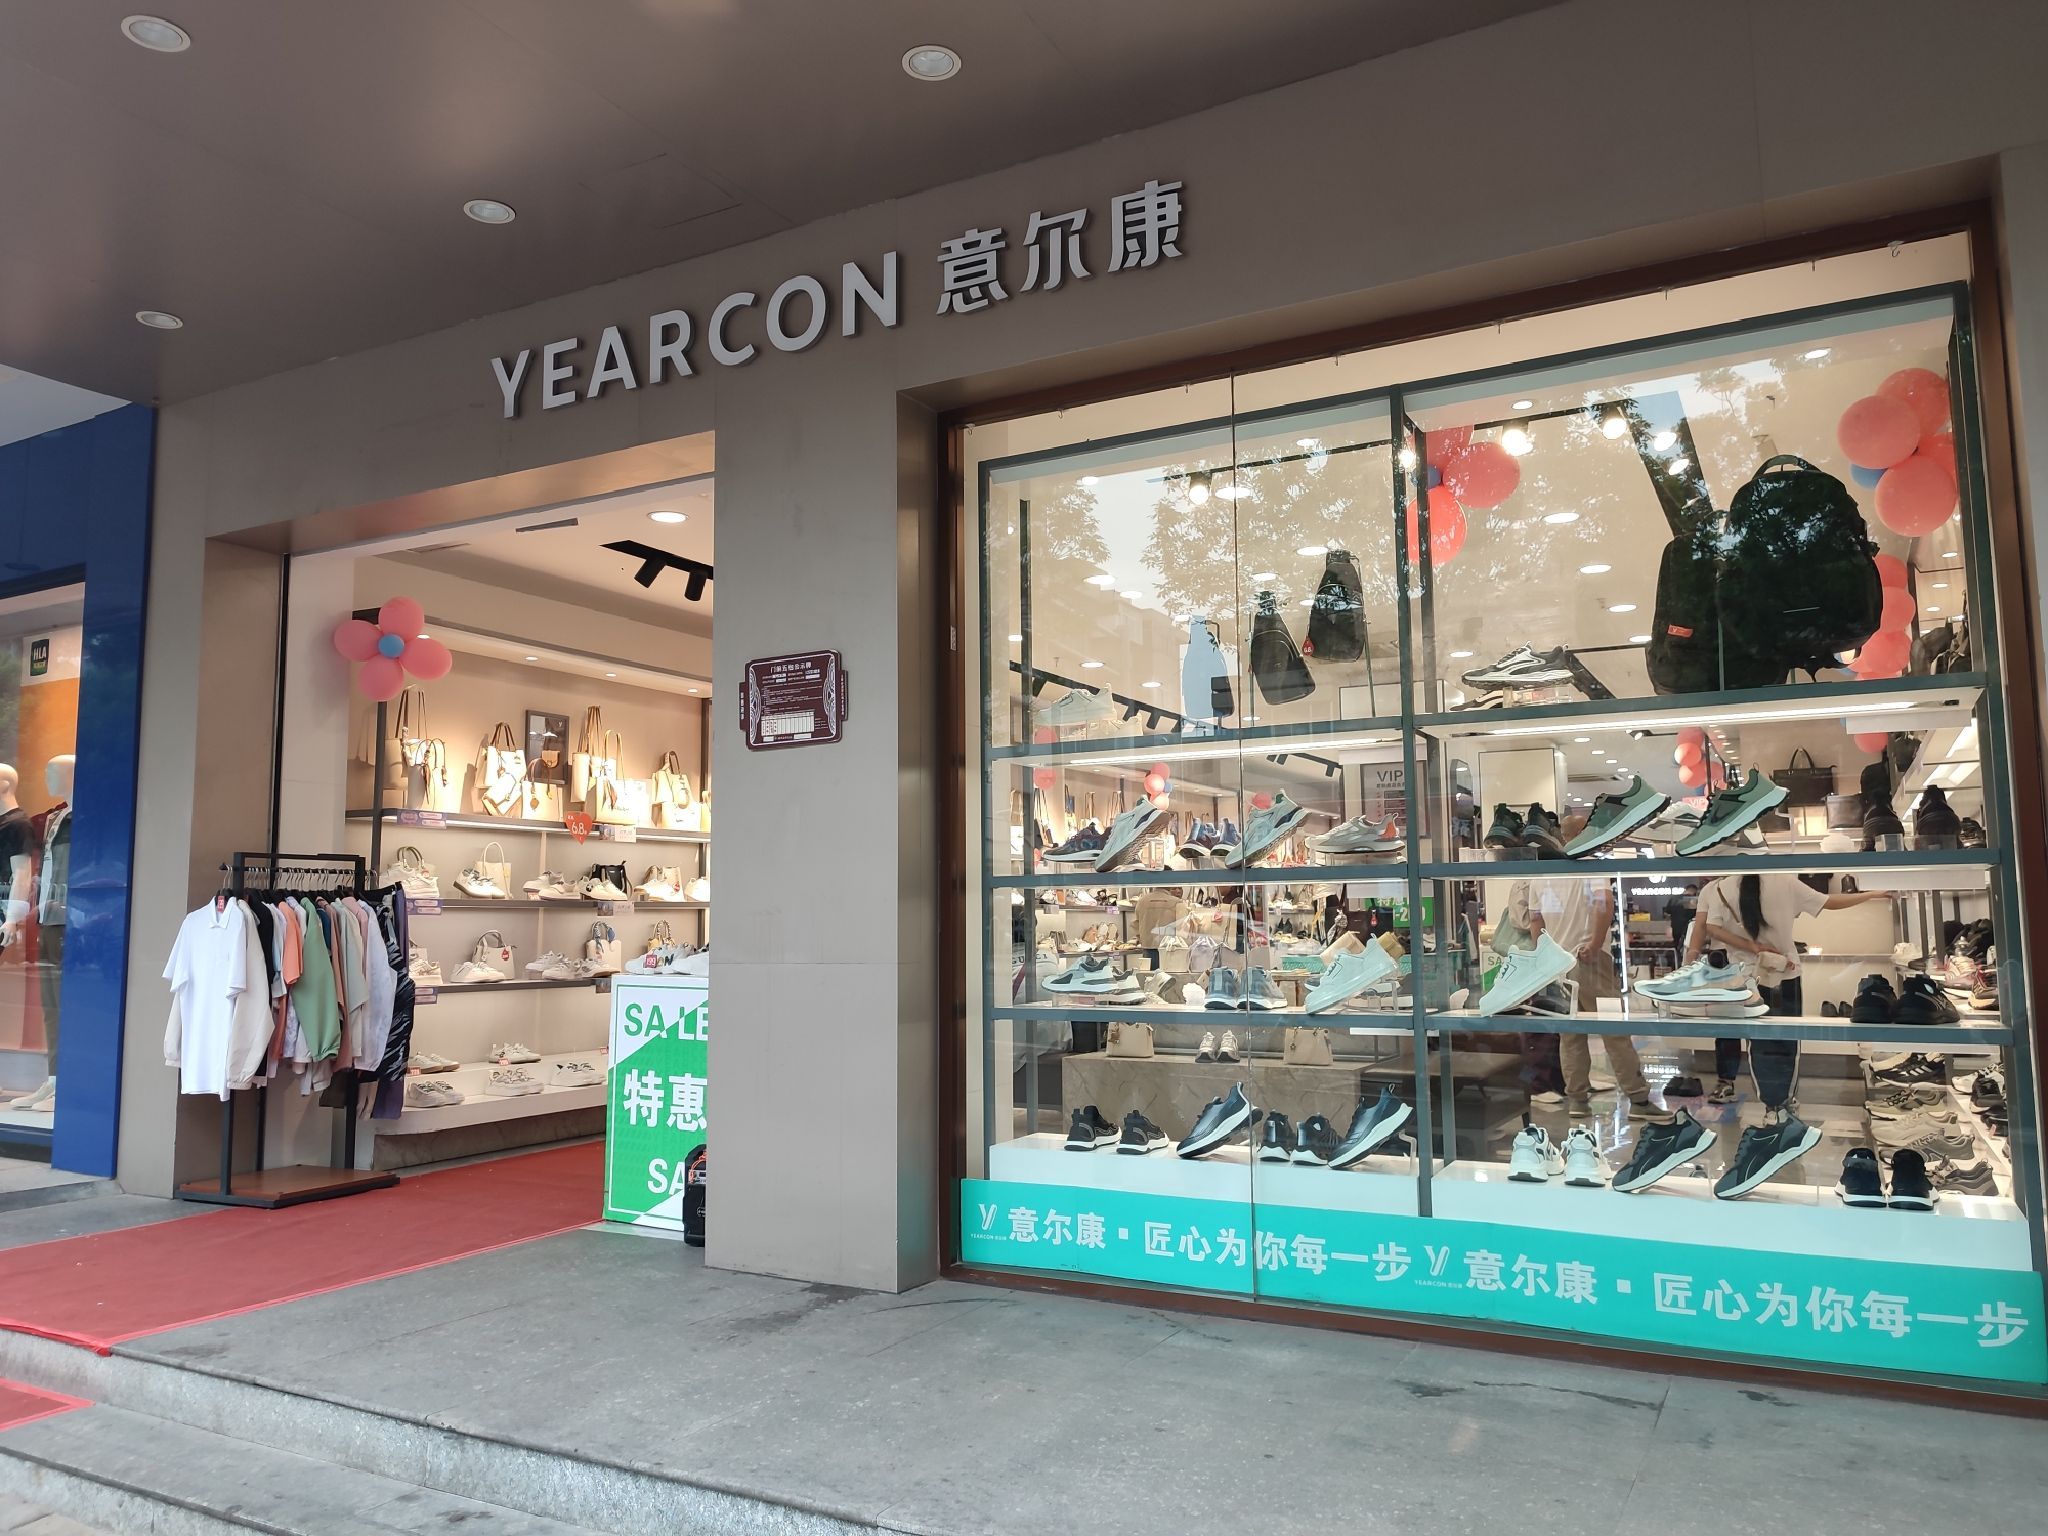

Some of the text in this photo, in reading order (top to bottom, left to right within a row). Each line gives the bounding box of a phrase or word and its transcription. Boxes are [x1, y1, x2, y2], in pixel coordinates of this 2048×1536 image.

[490, 178, 1186, 420] YEARCON 意尔康
[1376, 769, 1404, 783] VIP
[623, 1068, 708, 1133] 特惠
